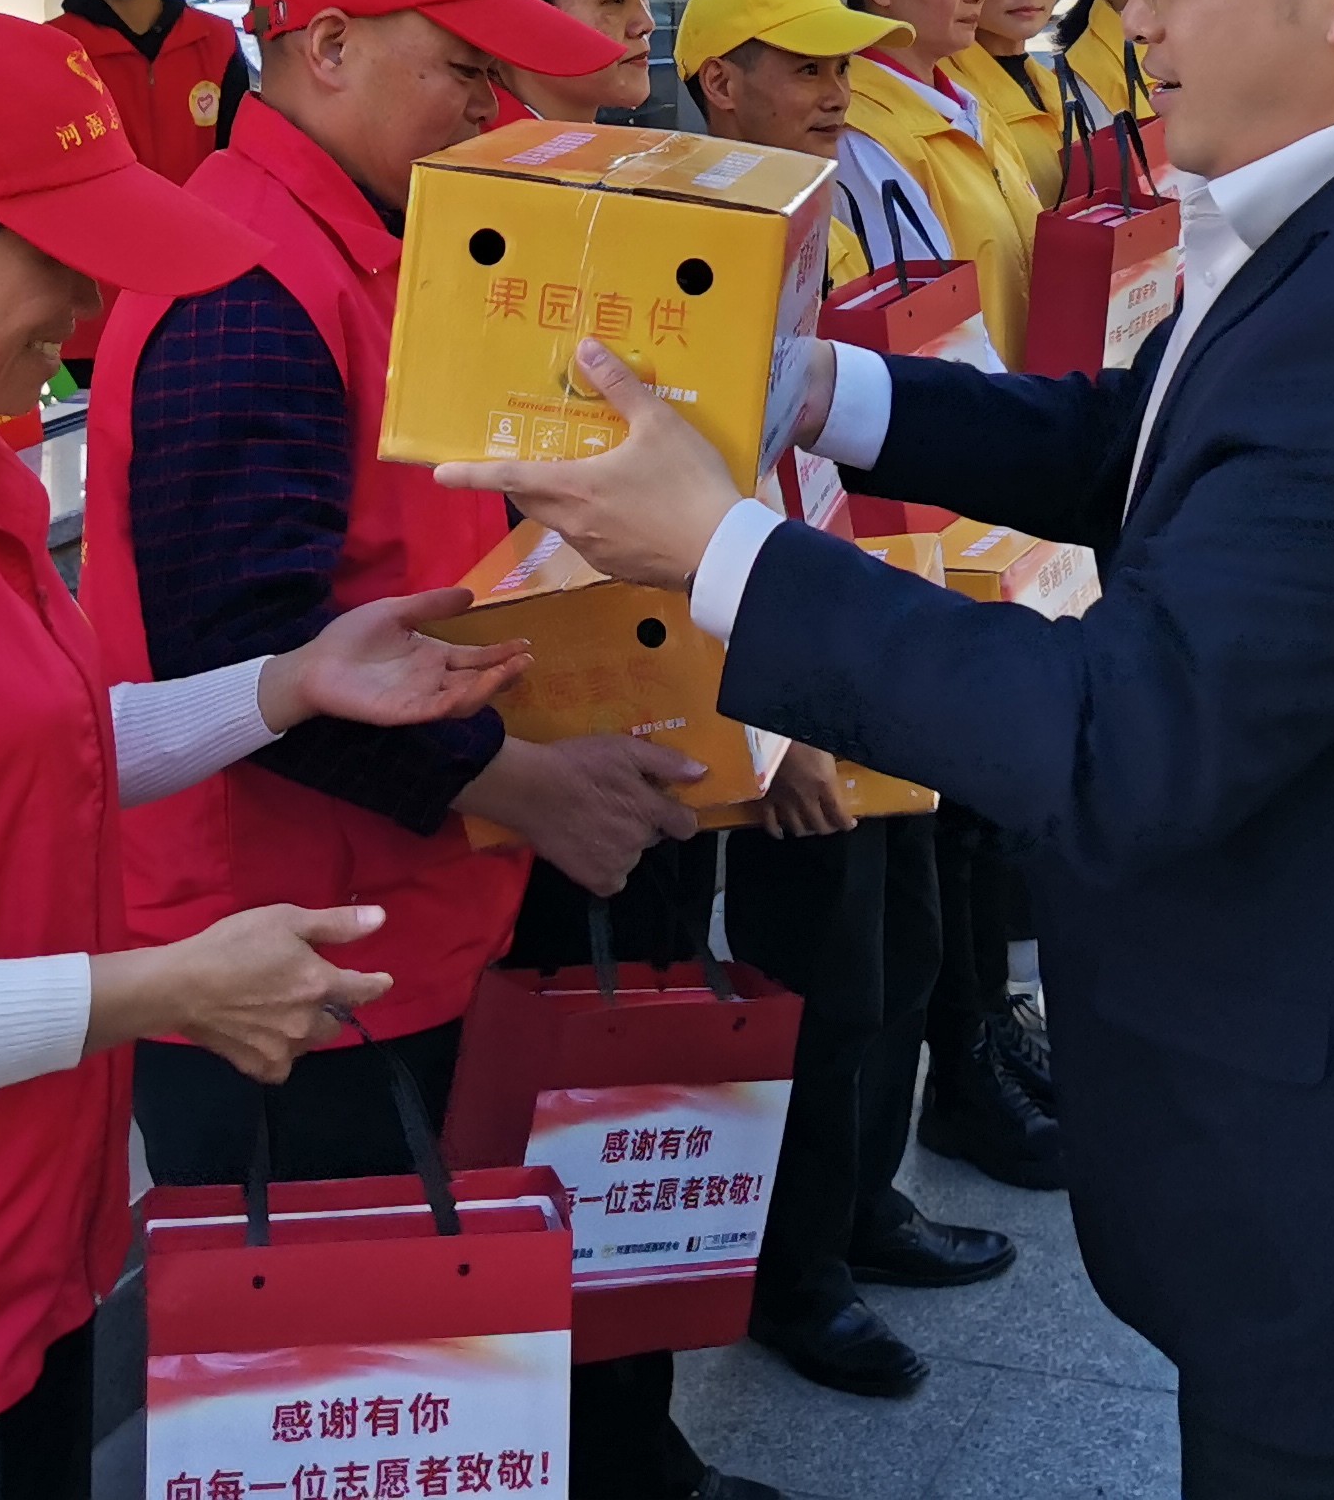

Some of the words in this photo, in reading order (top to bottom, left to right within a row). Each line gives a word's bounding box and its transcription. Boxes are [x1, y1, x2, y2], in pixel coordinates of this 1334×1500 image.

[484, 276, 694, 348] 果园直供
[600, 1124, 713, 1164] 感谢有你
[271, 1392, 451, 1443] 感谢有你
[165, 1450, 552, 1500] 向每一位志愿者致敬!
